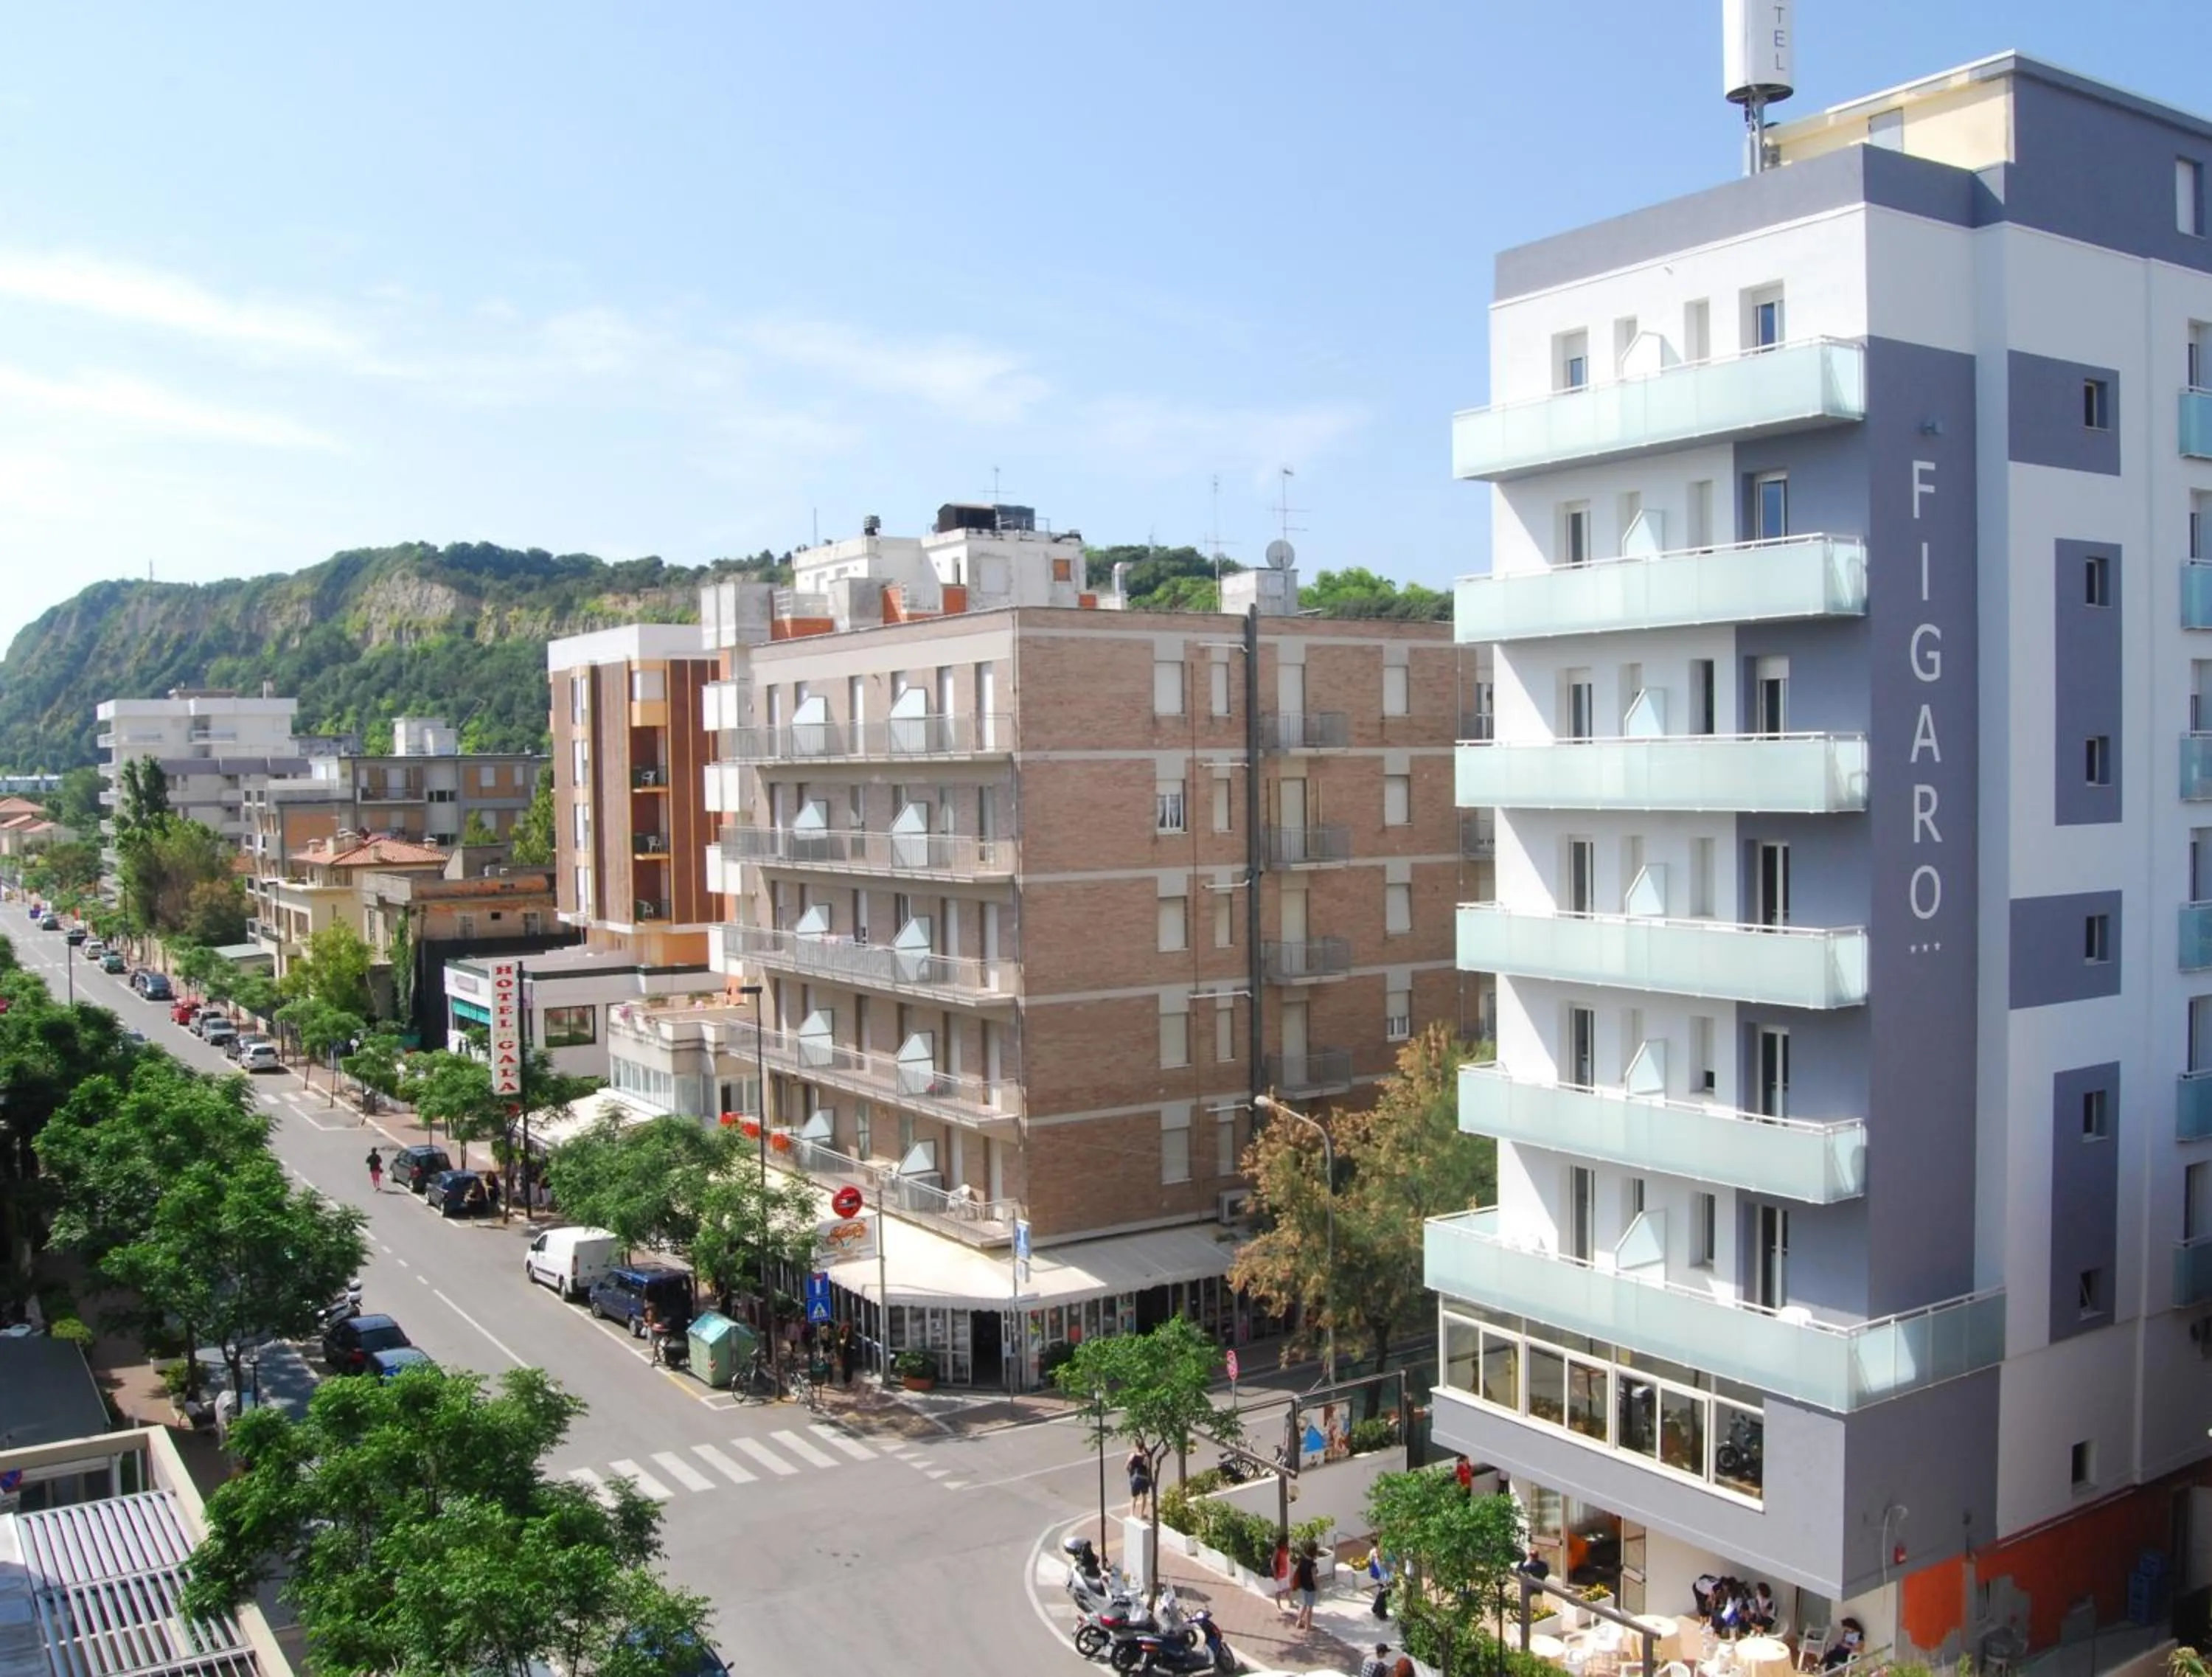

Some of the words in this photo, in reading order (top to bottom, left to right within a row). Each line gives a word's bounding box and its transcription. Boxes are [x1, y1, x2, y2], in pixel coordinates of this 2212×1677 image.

[1773, 0, 1786, 72] TEL
[1910, 460, 1942, 920] FIGARO
[495, 966, 513, 1027] HOTEL
[498, 1041, 516, 1091] GALA
